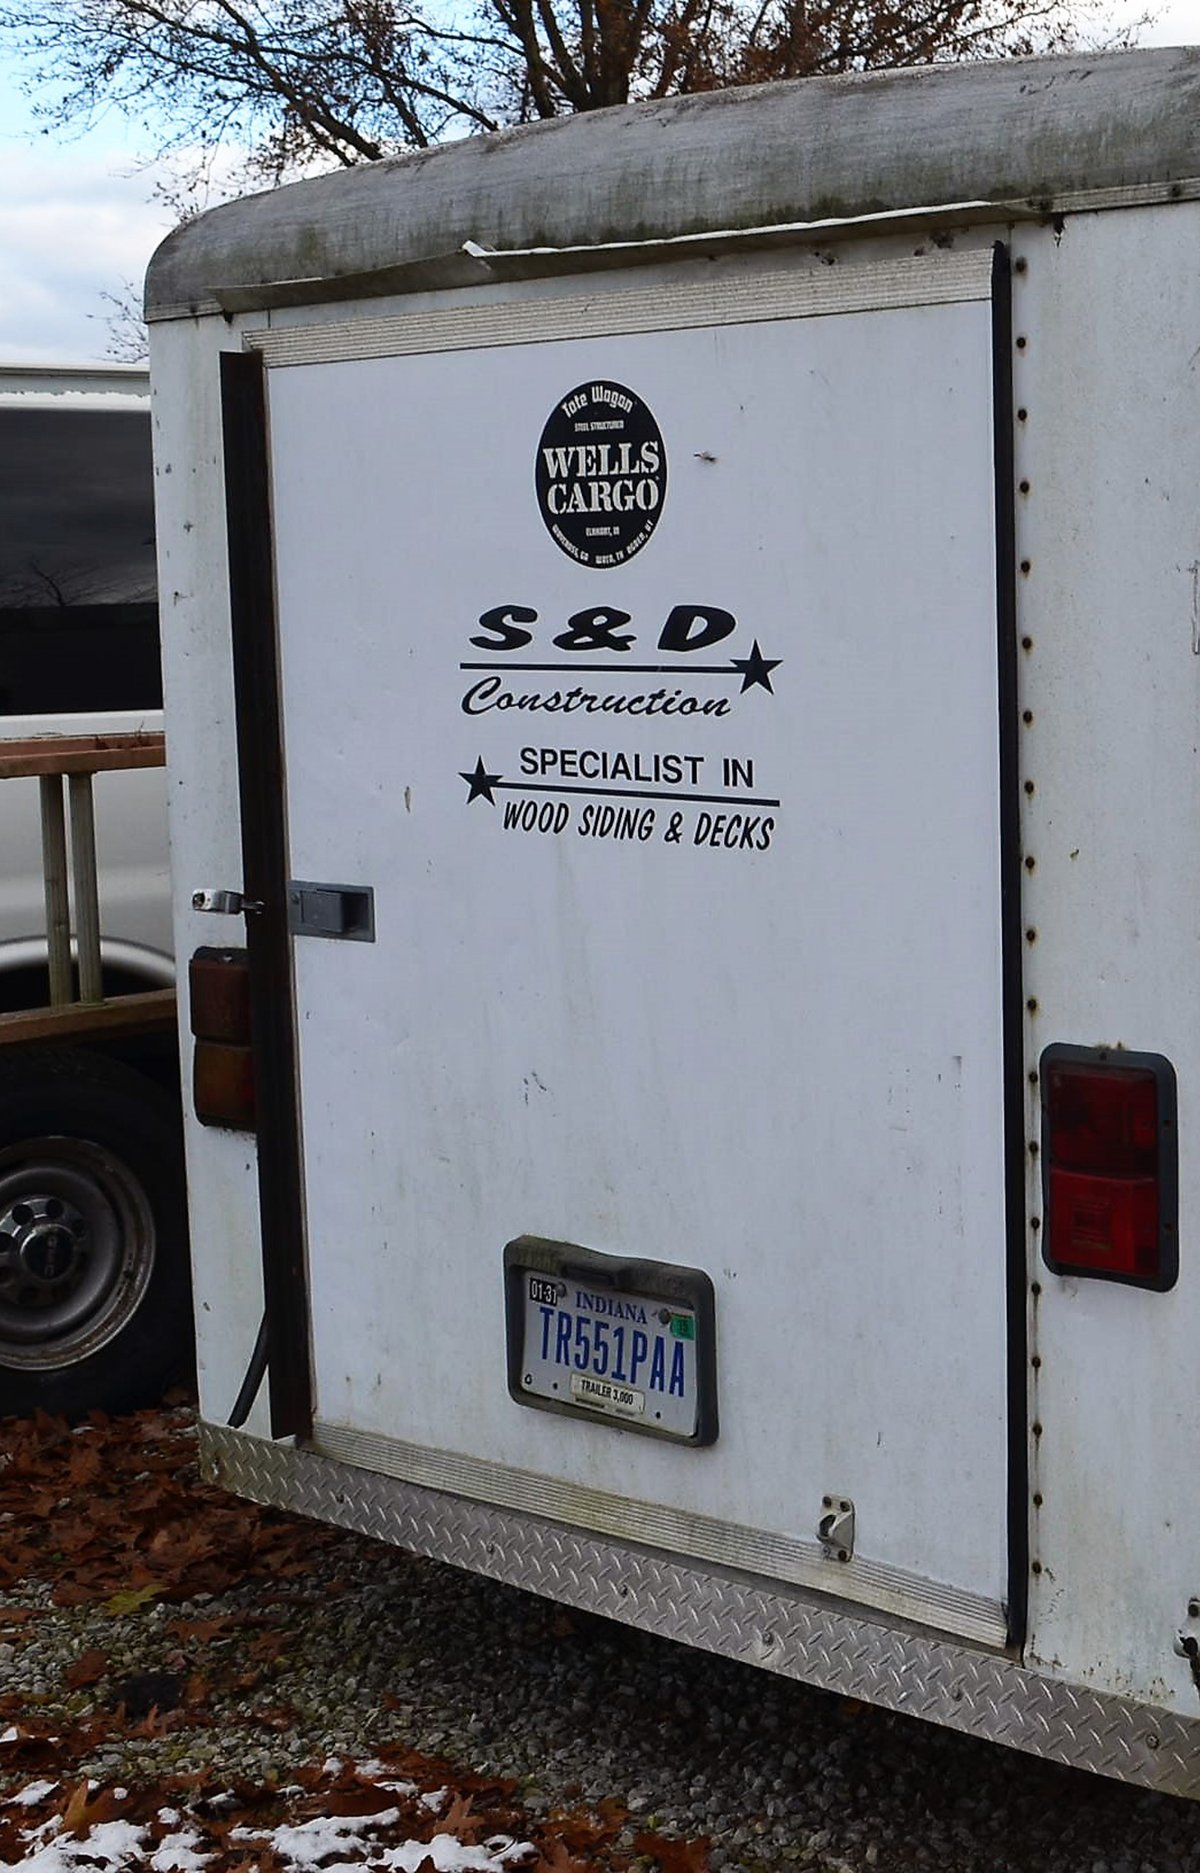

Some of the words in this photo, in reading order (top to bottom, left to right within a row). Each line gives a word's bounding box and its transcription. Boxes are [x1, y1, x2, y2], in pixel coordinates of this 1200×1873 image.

[562, 393, 588, 418] Tote
[592, 386, 633, 413] Wagon
[543, 441, 660, 479] WELLS
[547, 479, 659, 514] CARGO
[469, 604, 538, 651] S
[552, 605, 637, 651] &
[657, 604, 737, 652] D
[461, 676, 731, 718] Construction
[520, 747, 704, 785] SPECIALIST
[723, 758, 754, 788] IN
[502, 799, 569, 834] WOOD
[578, 804, 656, 842] SIDING
[664, 811, 684, 844] &
[694, 814, 775, 851] DECKS
[575, 1291, 648, 1324] INDIANA
[540, 1307, 684, 1397] TR551PAA
[581, 1379, 612, 1397] TRAILER
[613, 1388, 634, 1405] 3,000
